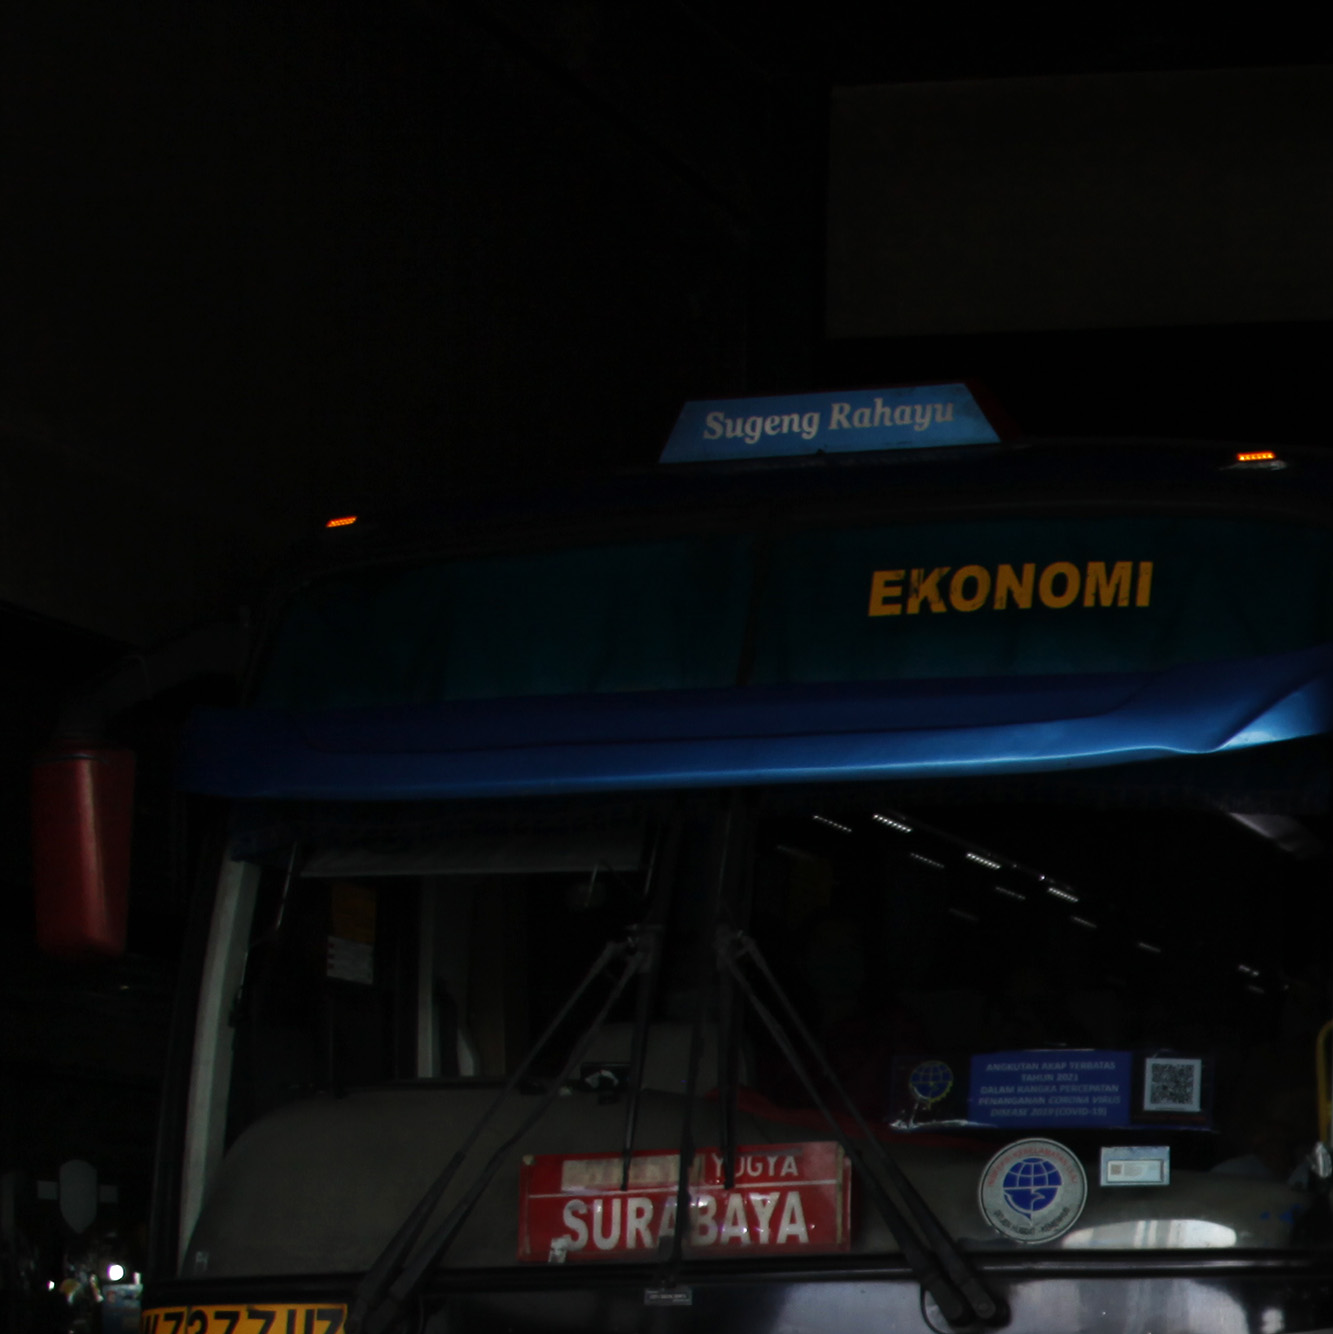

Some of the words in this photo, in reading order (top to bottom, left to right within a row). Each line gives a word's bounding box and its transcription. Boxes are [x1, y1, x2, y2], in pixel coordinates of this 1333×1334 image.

[702, 410, 821, 445] Sugeng
[828, 397, 955, 432] Rahayu
[867, 560, 1155, 617] EKONOMI
[562, 1191, 809, 1251] SURABAYA
